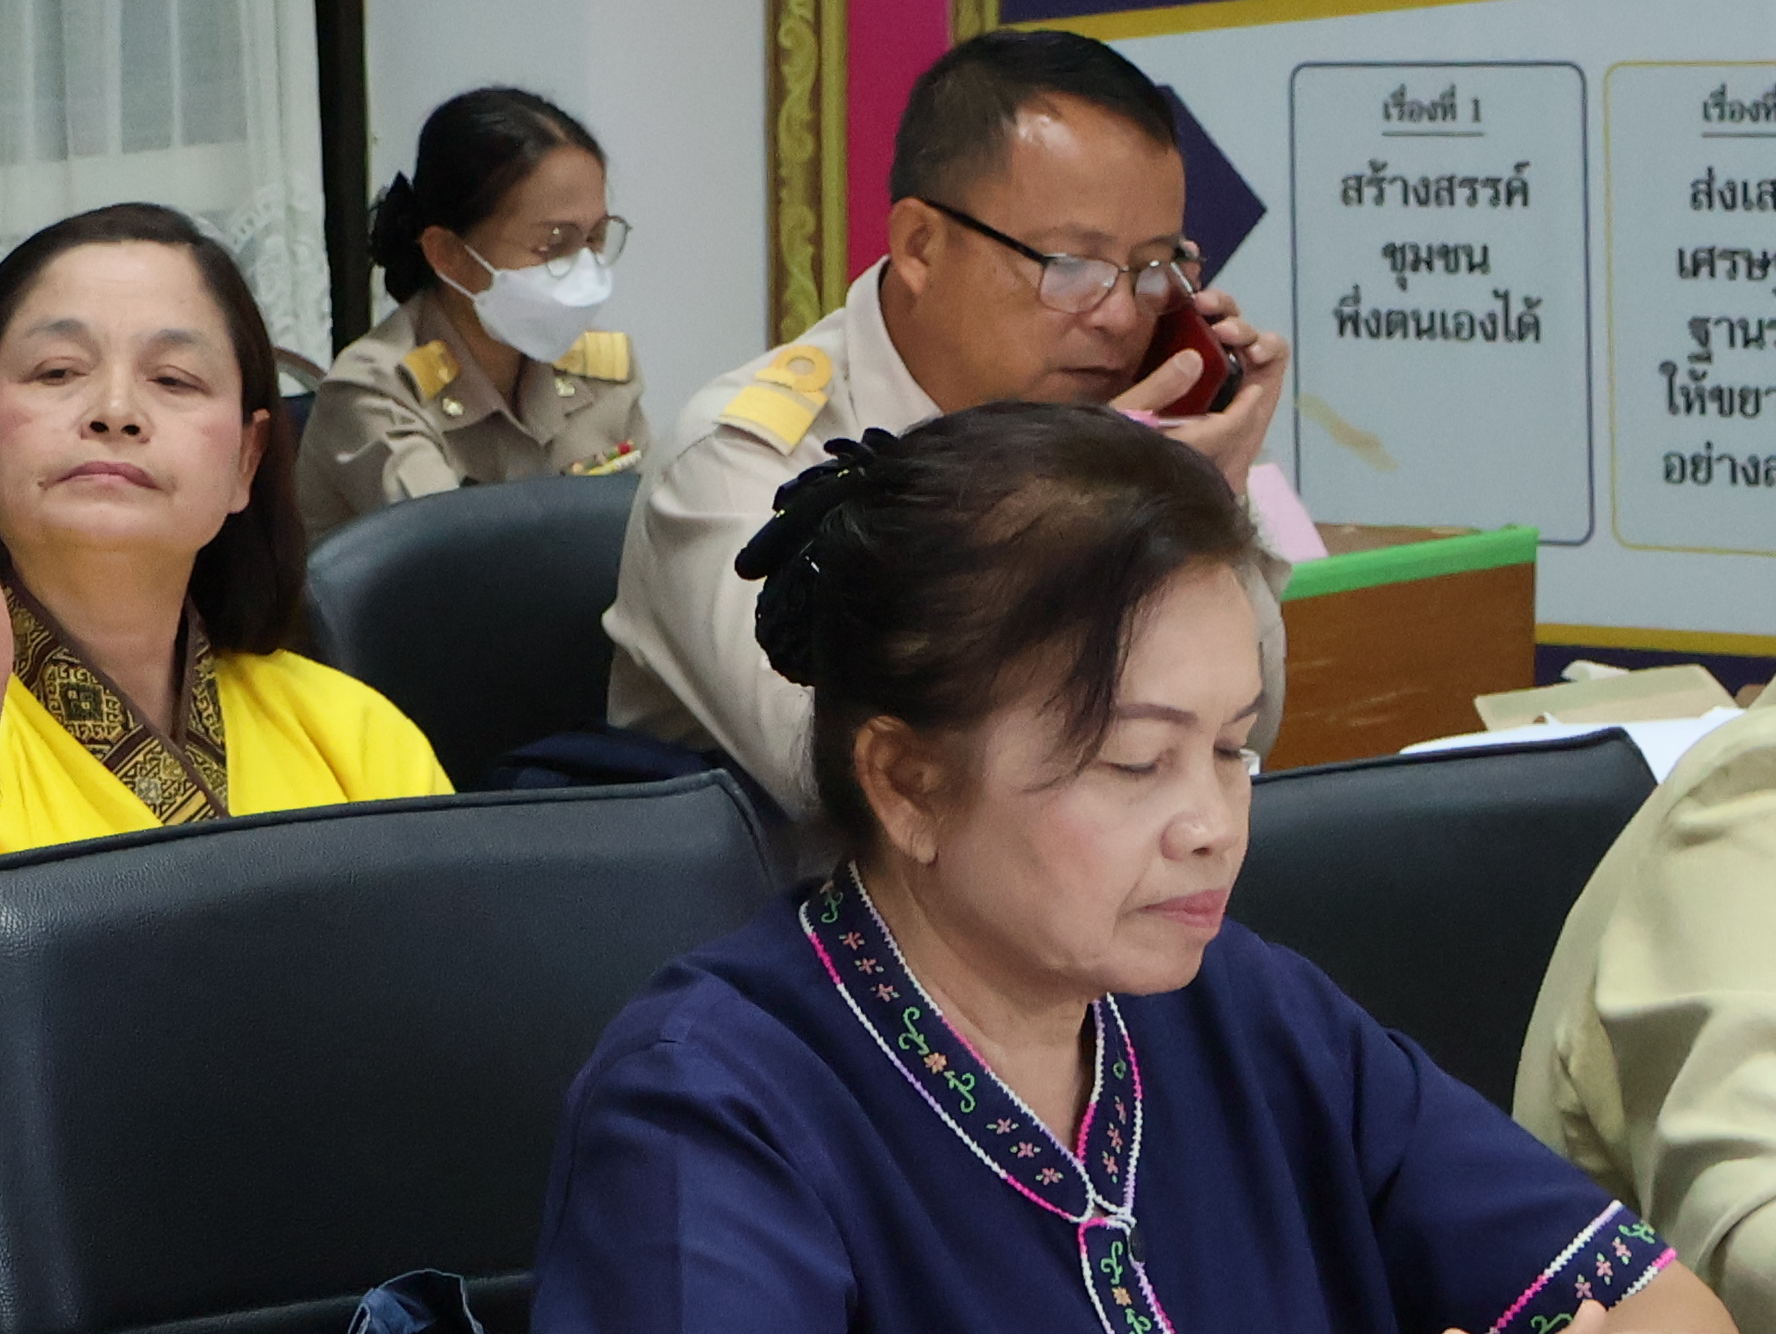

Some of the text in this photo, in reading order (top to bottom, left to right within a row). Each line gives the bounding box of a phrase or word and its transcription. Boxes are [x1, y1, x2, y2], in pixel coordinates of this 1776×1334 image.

[1382, 85, 1482, 124] เรื่องที่ 1
[1340, 159, 1532, 209] สร้างสรรค์
[1382, 239, 1491, 291] ชุมชน
[1677, 245, 1776, 295] เศรษ
[1334, 285, 1543, 344] พึ่งตนเองได้
